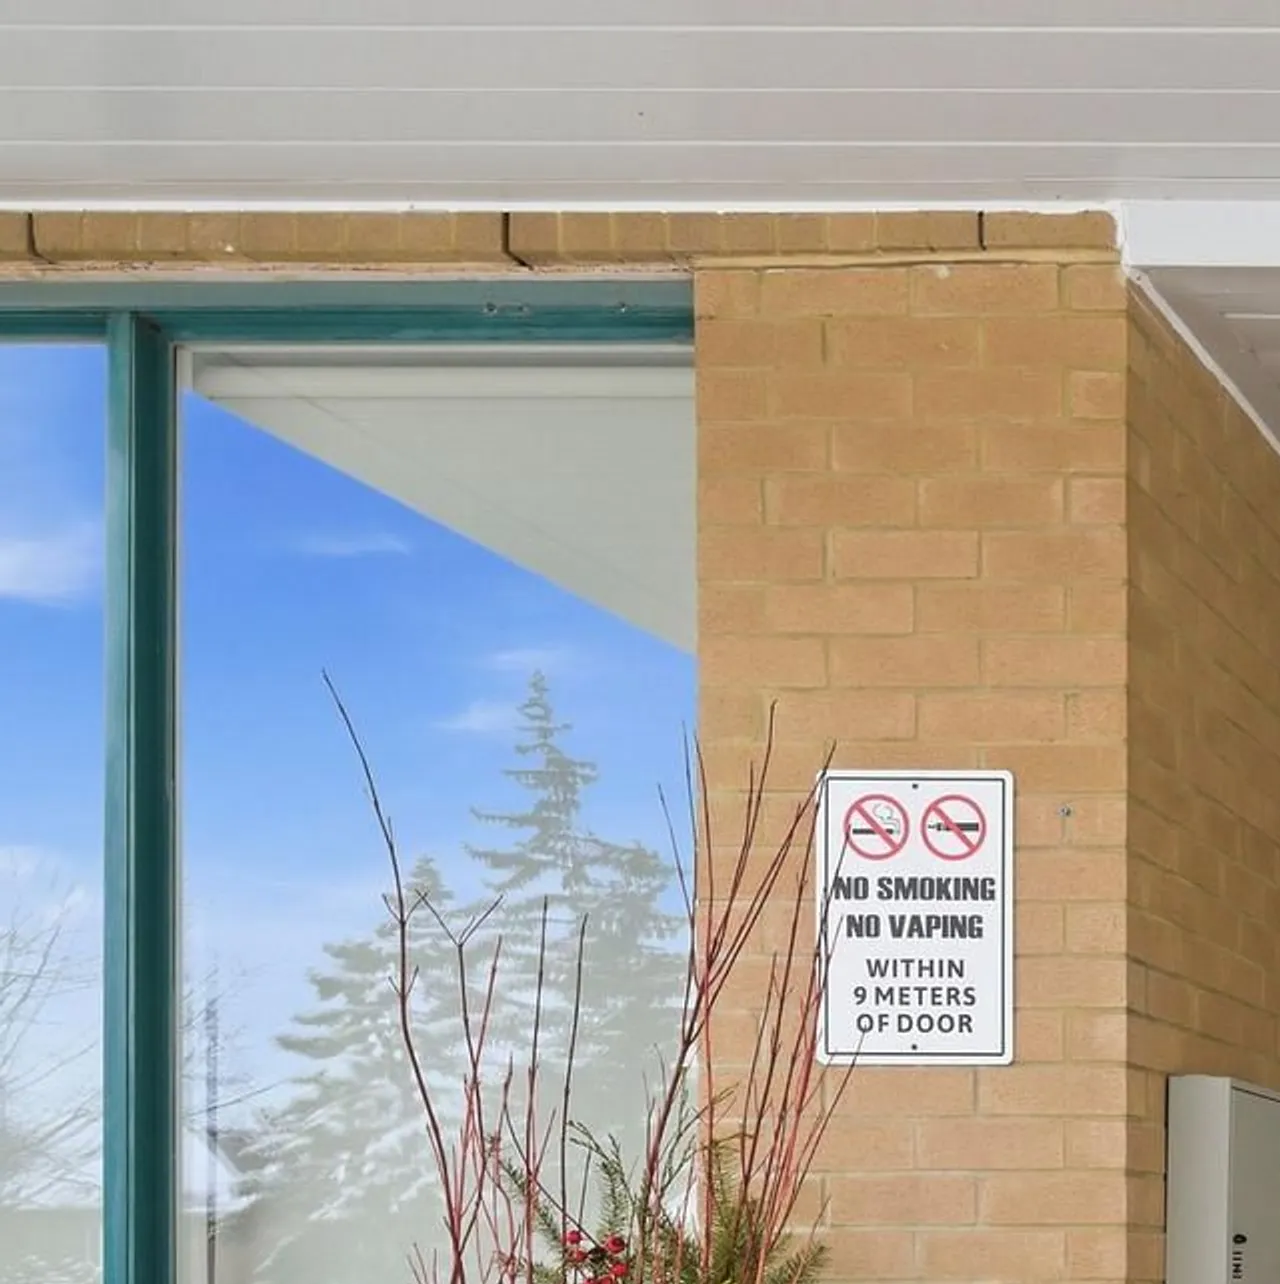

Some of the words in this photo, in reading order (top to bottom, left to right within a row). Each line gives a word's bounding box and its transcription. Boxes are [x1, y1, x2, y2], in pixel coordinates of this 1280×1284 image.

[834, 876, 870, 901] NO
[877, 876, 997, 901] SMOKING
[846, 914, 880, 939] NO
[889, 914, 984, 939] VAPING
[865, 958, 965, 978] WITHIN
[853, 986, 867, 1006] 9
[875, 986, 977, 1006] METERS
[856, 1013, 891, 1033] OF
[898, 1013, 974, 1033] DOOR
